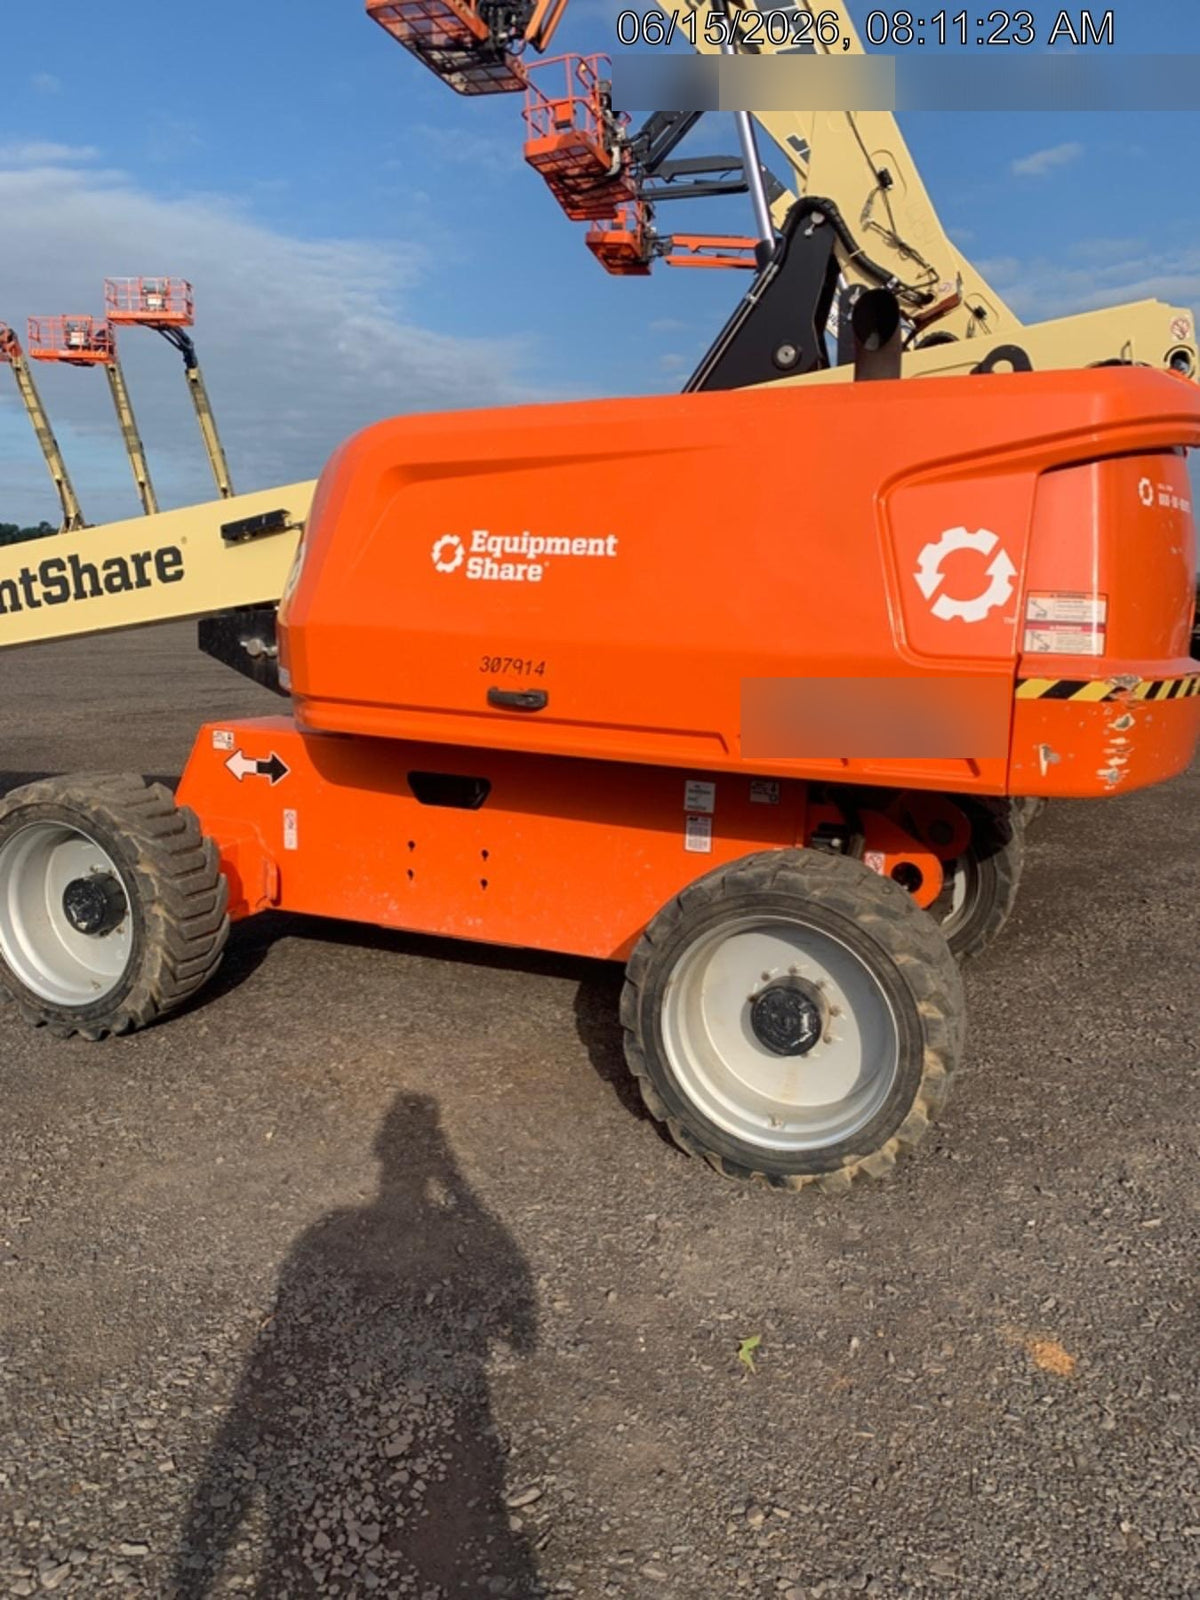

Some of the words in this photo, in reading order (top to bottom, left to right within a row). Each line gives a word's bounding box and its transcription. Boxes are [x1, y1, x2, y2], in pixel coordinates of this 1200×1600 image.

[470, 530, 618, 558] Equipment
[466, 557, 543, 582] Share
[479, 655, 546, 676] 307914
